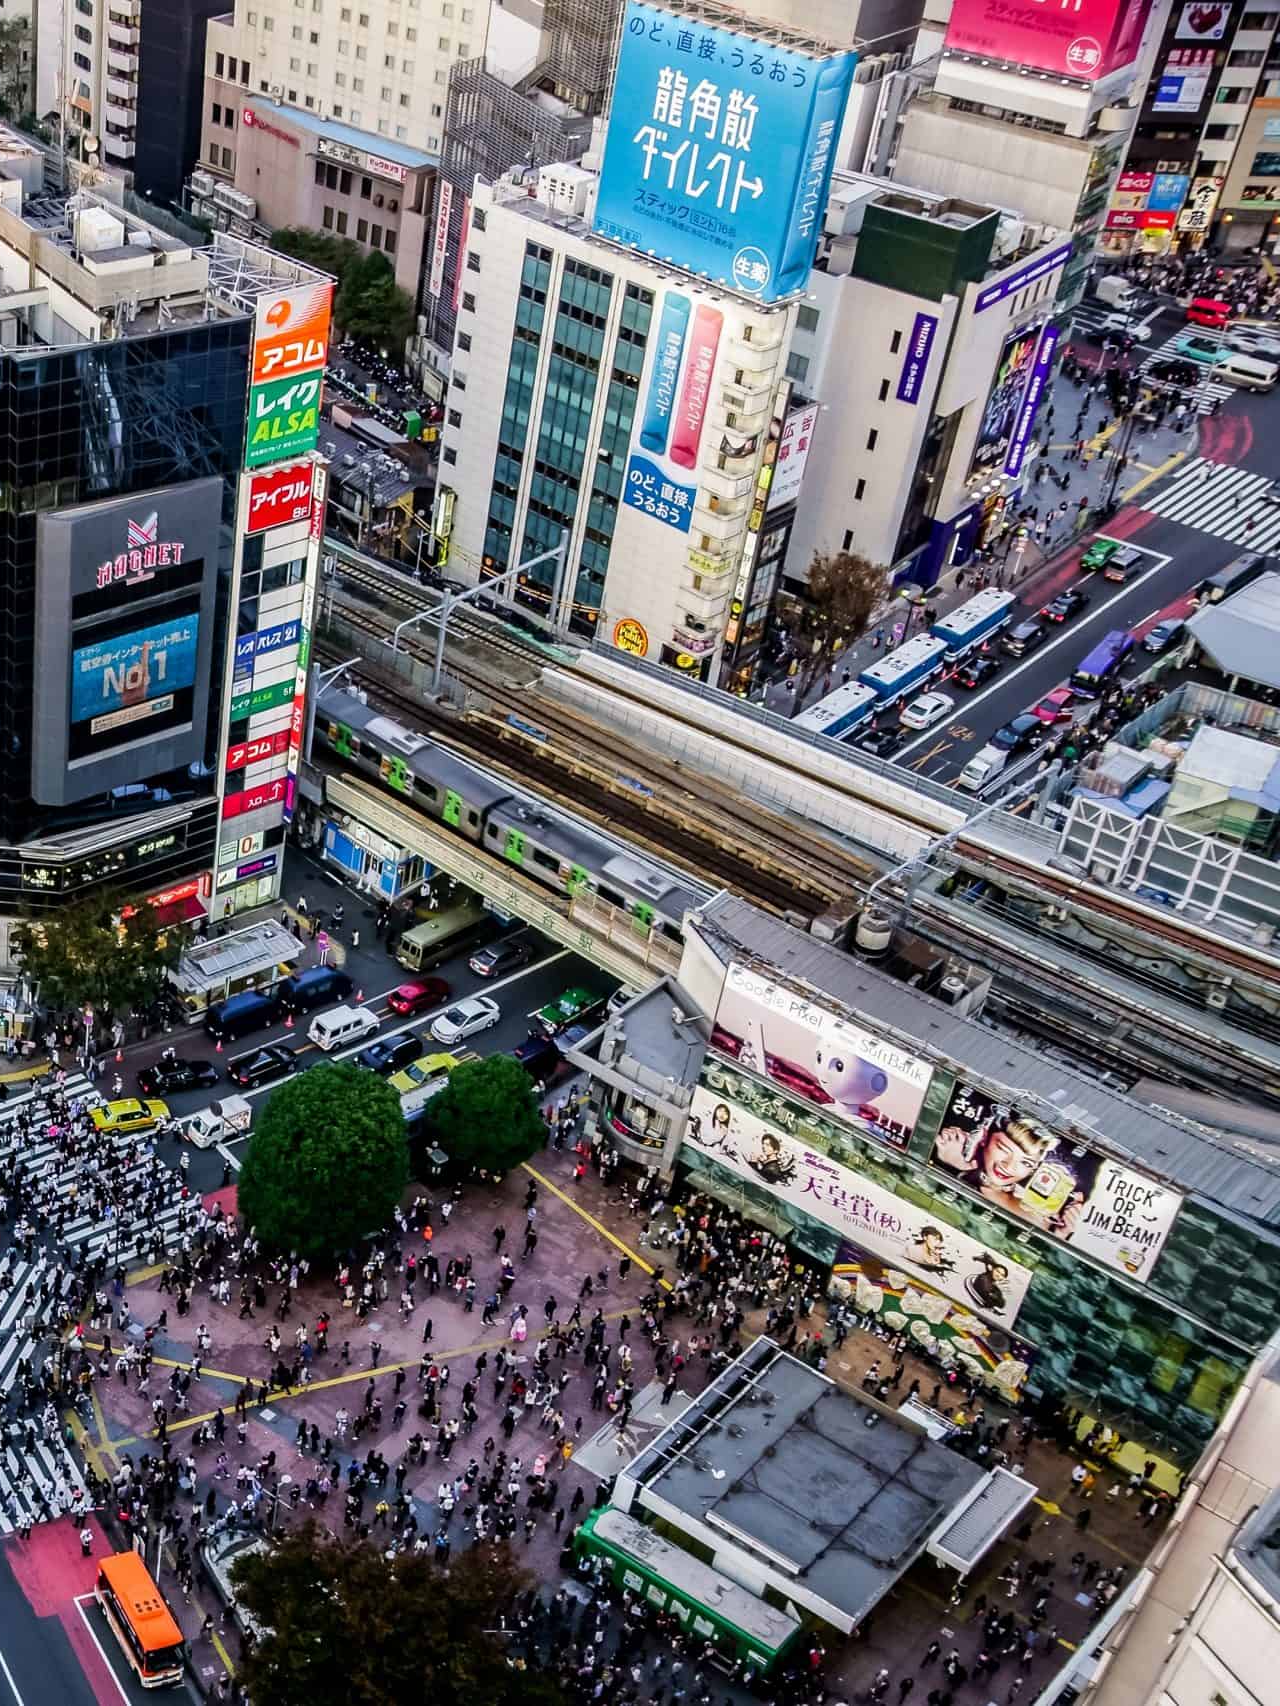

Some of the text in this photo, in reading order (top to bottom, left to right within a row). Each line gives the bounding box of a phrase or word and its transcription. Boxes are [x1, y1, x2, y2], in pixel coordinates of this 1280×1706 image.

[652, 65, 760, 153] 龍角散
[633, 124, 765, 214] ダイレクト
[633, 188, 690, 220] スティック
[735, 256, 769, 284] 生薬
[261, 339, 325, 375] アコム
[256, 379, 320, 418] レイク
[250, 407, 317, 445] ALSA
[252, 480, 311, 512] アイフル
[632, 490, 681, 525] うるおう
[96, 542, 185, 589] MAGNET
[231, 741, 271, 764] アコム
[789, 1000, 825, 1028] Pixel
[1105, 1168, 1155, 1208] TRICK
[1112, 1197, 1136, 1218] OR
